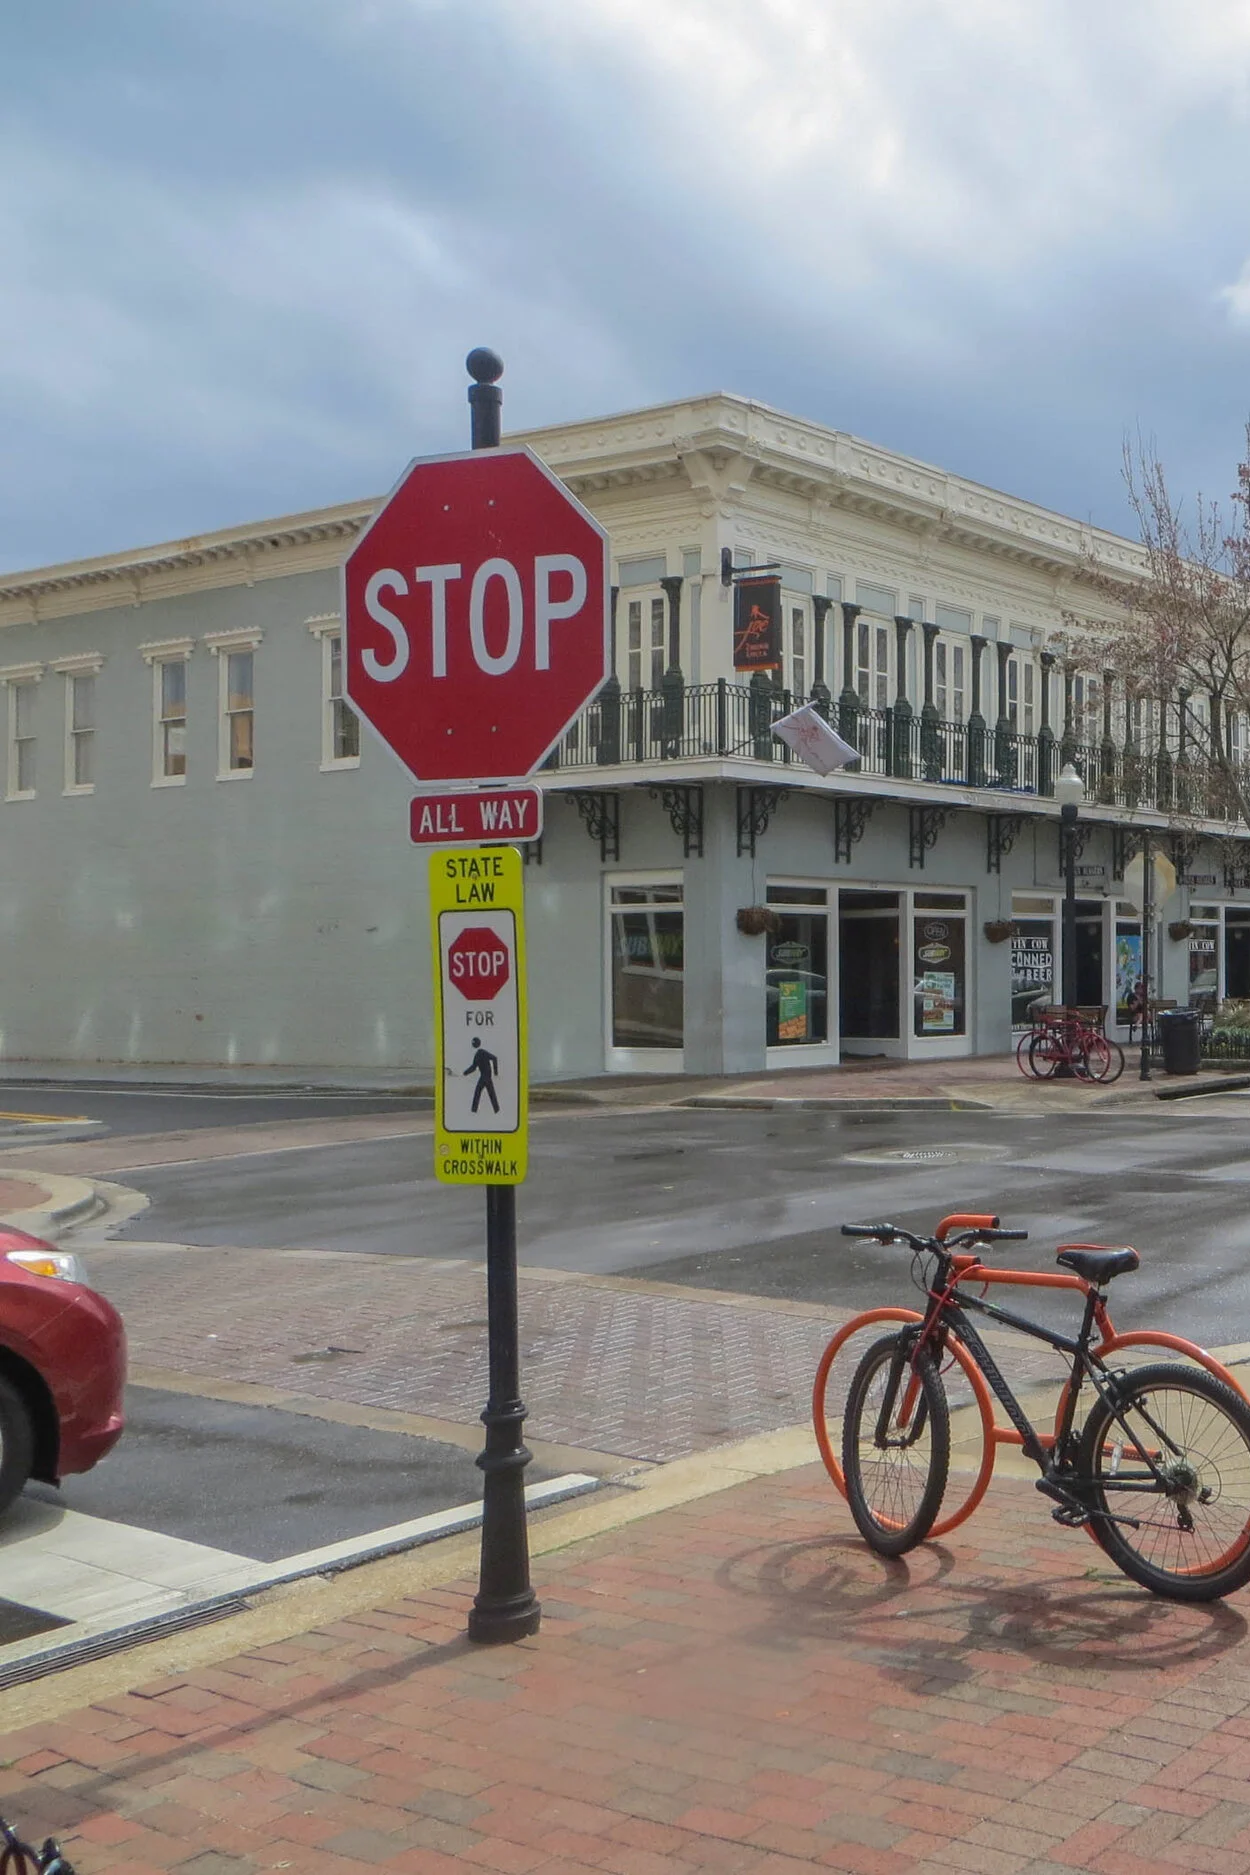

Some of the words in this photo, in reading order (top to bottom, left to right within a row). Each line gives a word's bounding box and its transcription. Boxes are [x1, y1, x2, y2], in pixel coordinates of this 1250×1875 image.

[361, 554, 588, 683] STOP
[419, 804, 464, 834] ALL
[480, 799, 529, 830] WAY
[446, 857, 504, 878] STATE
[456, 883, 495, 903] LAW
[1031, 939, 1049, 949] COW
[452, 951, 505, 977] STOP
[1026, 969, 1052, 981] BEER
[466, 1011, 494, 1027] FOR
[460, 1139, 502, 1154] WITHIN
[443, 1159, 517, 1176] CROSSWALK
